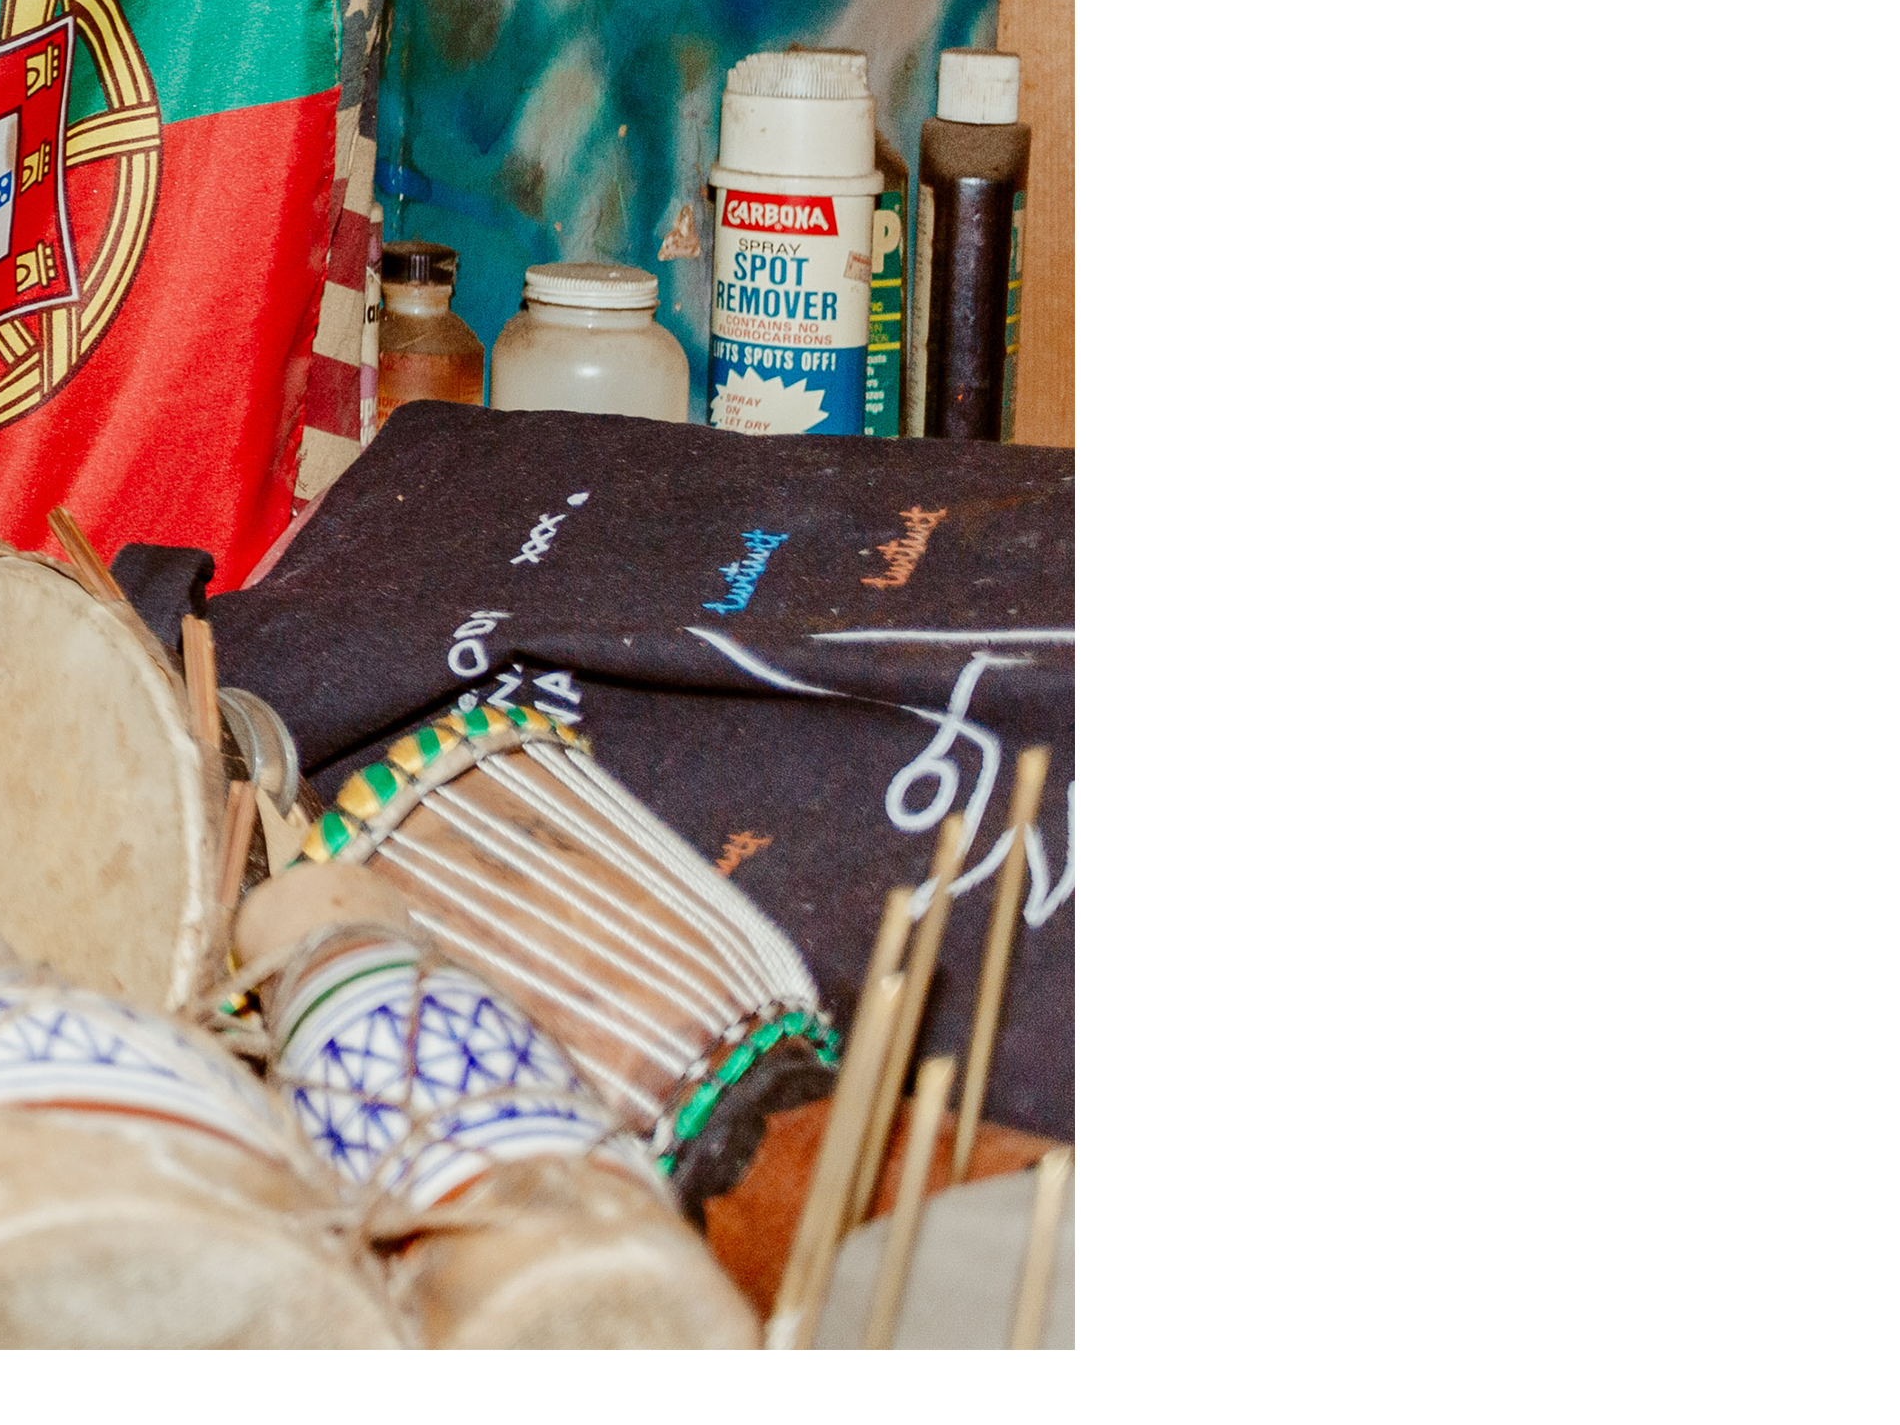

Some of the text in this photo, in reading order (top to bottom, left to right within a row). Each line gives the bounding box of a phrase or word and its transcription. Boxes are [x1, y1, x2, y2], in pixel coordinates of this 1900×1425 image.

[726, 199, 830, 232] CARBONA
[737, 237, 802, 256] SPRAY
[733, 251, 810, 287] SPOT
[715, 279, 838, 322] REMOVER
[725, 314, 820, 334] CONTAINS NO
[711, 339, 838, 373] LIFTS SPOTS OFF!
[725, 392, 762, 409] SPRAY
[725, 405, 741, 416] ON
[724, 416, 772, 432] LET DRY
